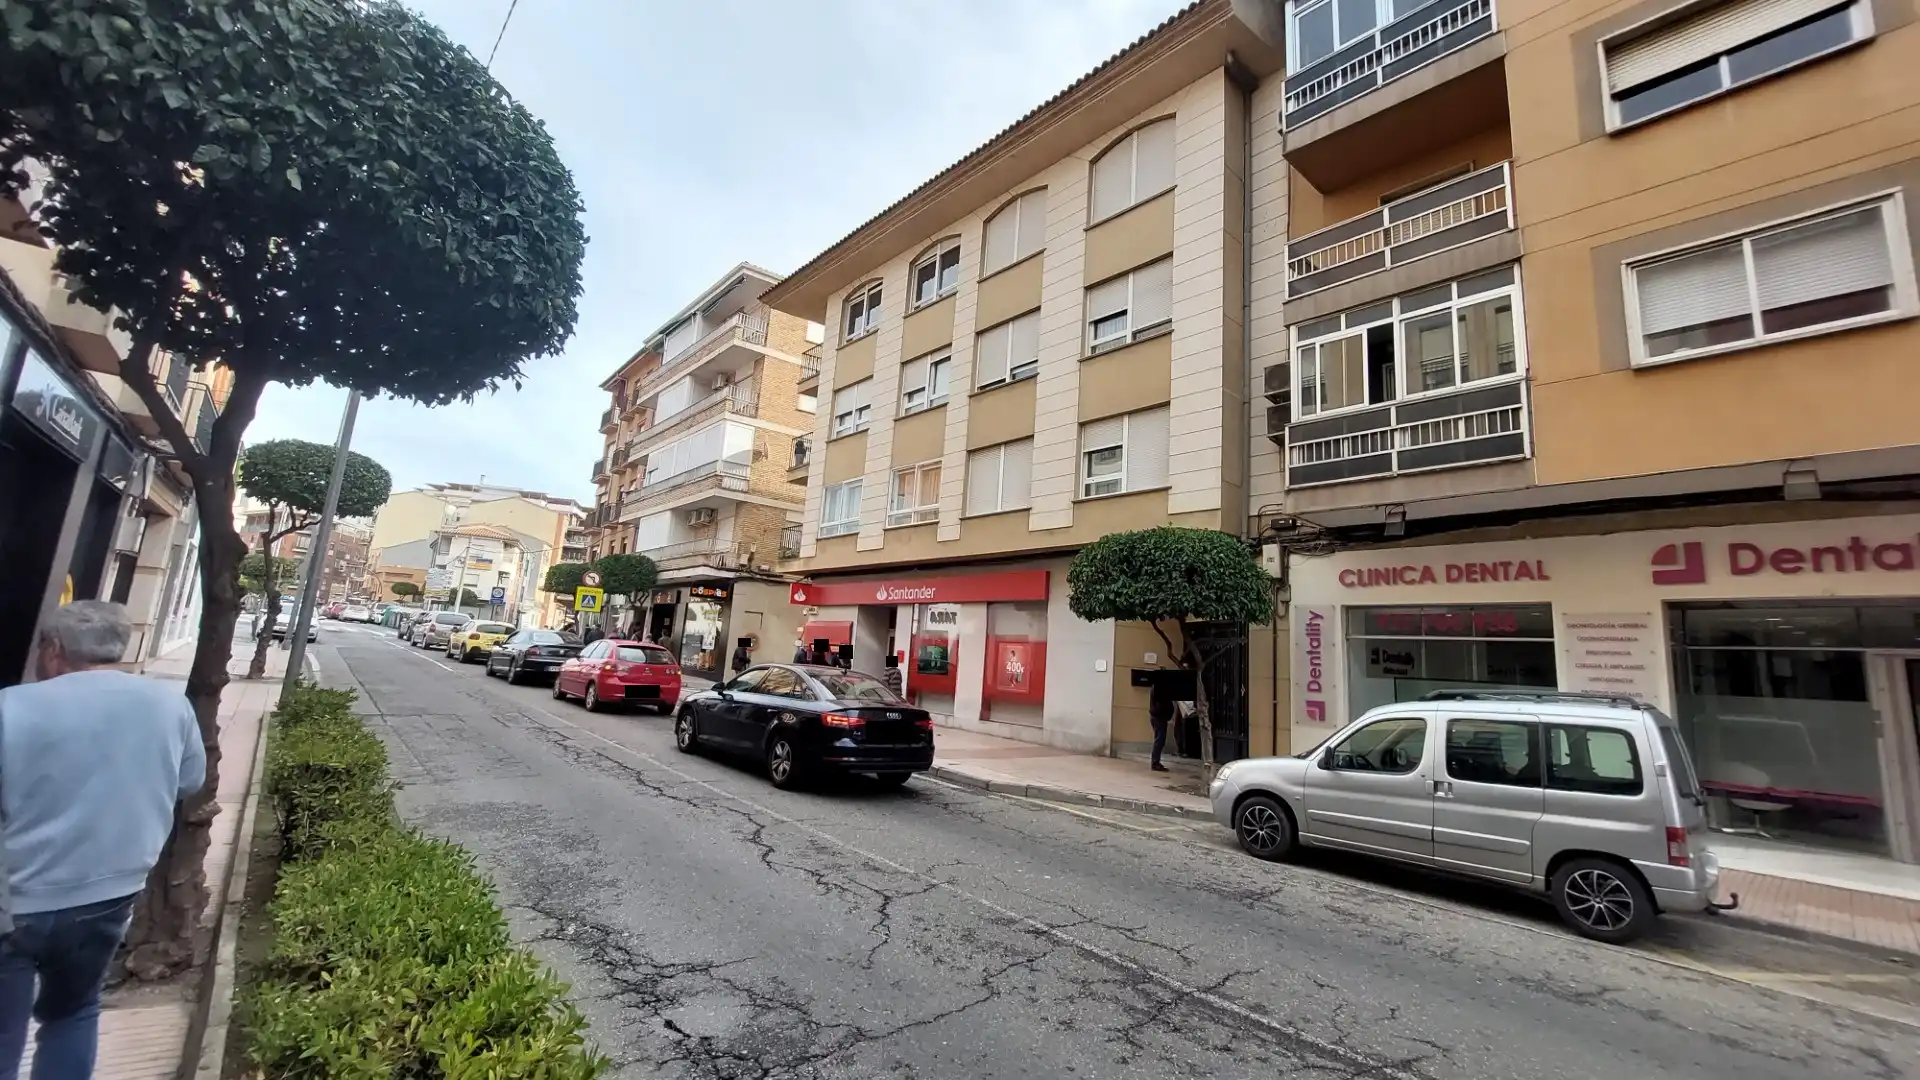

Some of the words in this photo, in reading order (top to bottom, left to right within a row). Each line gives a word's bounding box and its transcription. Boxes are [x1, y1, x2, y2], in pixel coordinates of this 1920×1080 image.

[1338, 565, 1438, 588] CLINICA
[1445, 560, 1552, 583] DENTAL
[888, 586, 936, 600] Santander
[1305, 610, 1324, 694] Dentality
